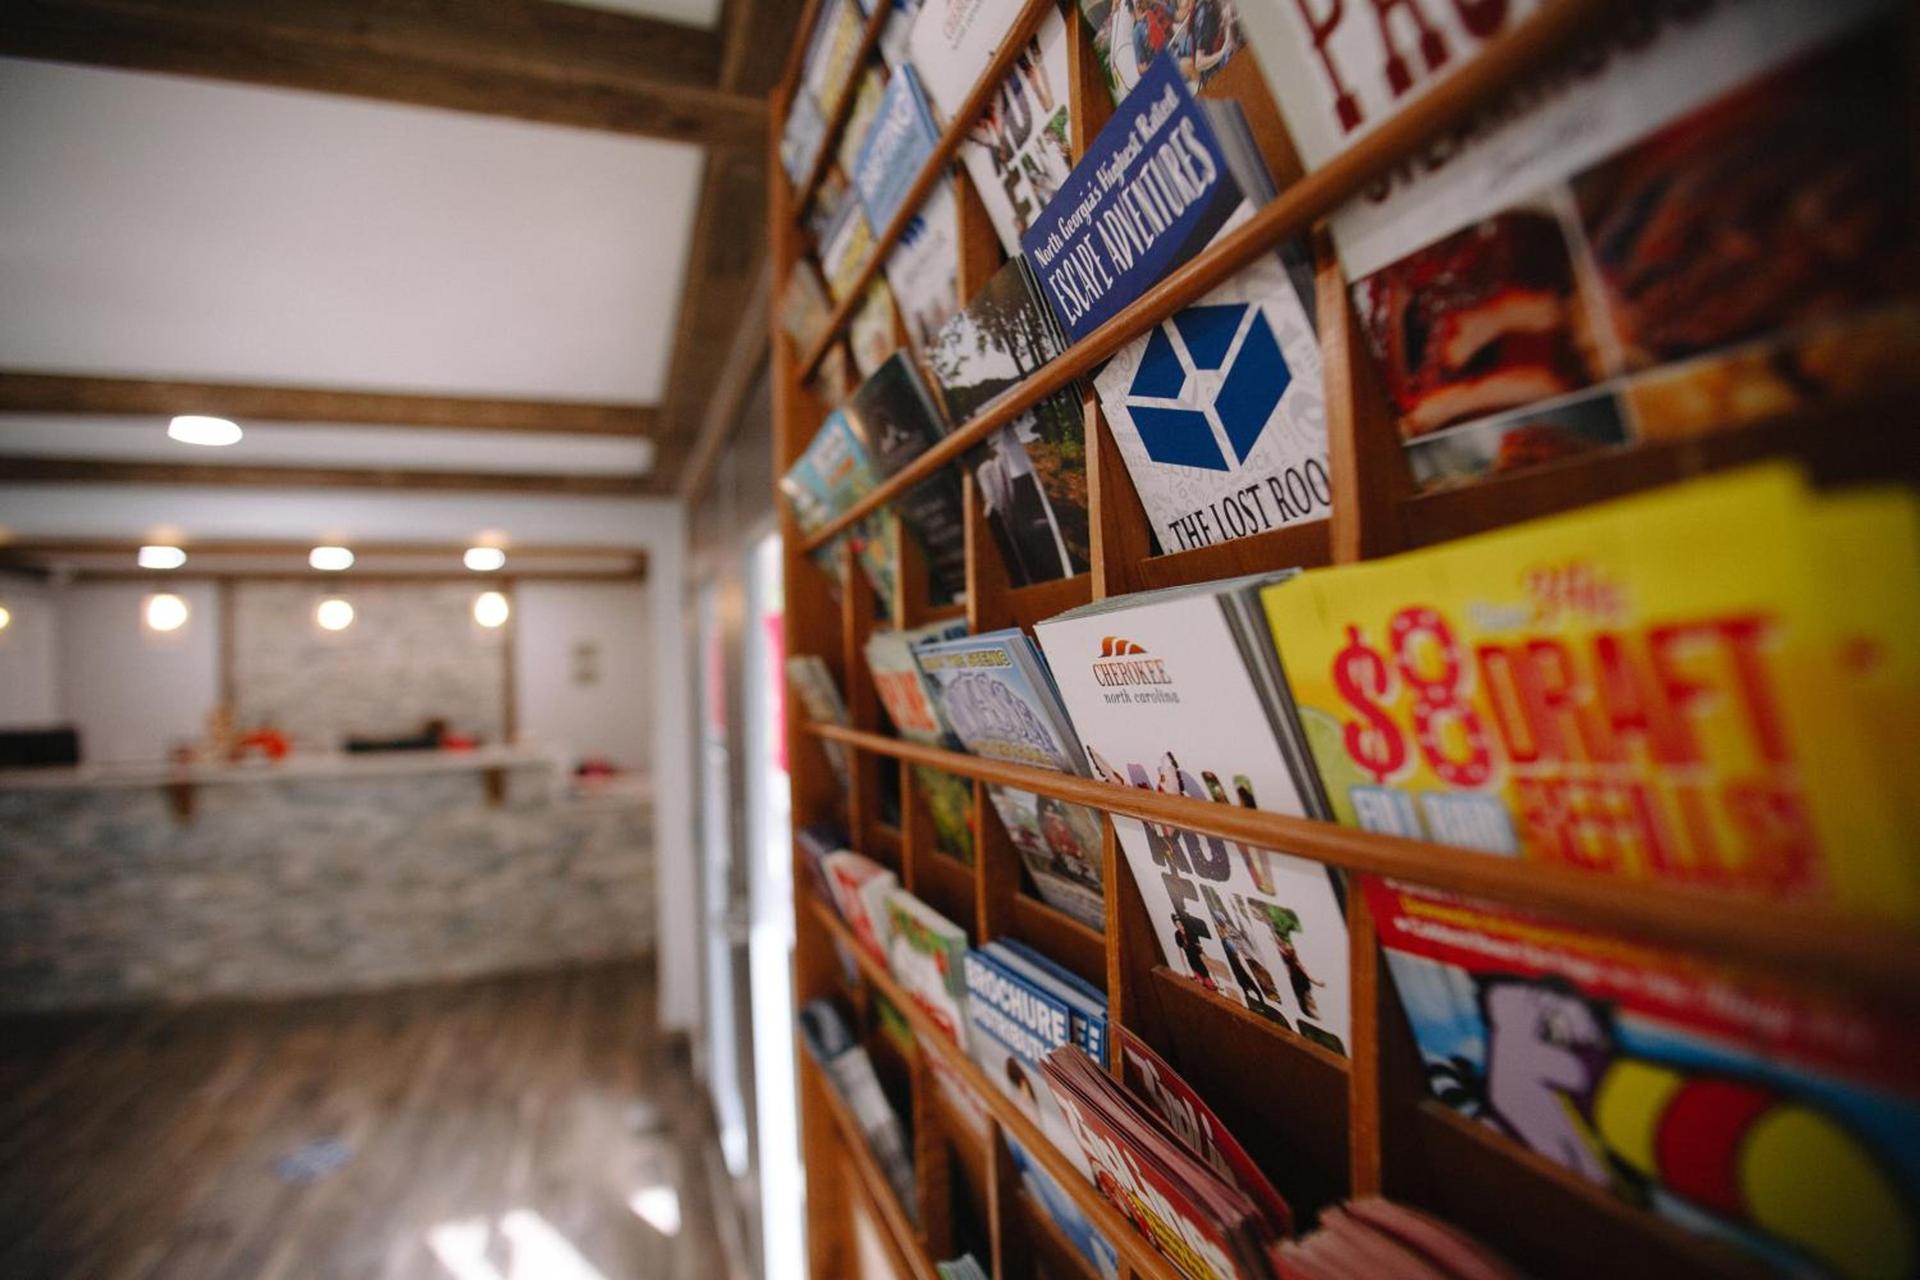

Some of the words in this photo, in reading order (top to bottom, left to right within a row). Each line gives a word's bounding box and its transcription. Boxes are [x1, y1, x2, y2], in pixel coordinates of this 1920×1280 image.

[1034, 231, 1063, 268] North
[1057, 181, 1103, 240] Georgia's
[1096, 131, 1143, 193] Highest
[1135, 82, 1181, 143] Rated
[1049, 233, 1113, 327] ESCAPE
[1096, 116, 1217, 275] ADVENTURES
[1168, 510, 1211, 550] THE
[1209, 484, 1262, 540] LOST
[1266, 458, 1333, 522] ROO
[1092, 659, 1172, 687] CHEROKEE
[1104, 688, 1132, 704] north
[1134, 687, 1181, 704] carolina
[1333, 606, 1495, 786] $8
[1475, 610, 1795, 768] DRAFT
[963, 955, 1067, 1047] BROCHURE
